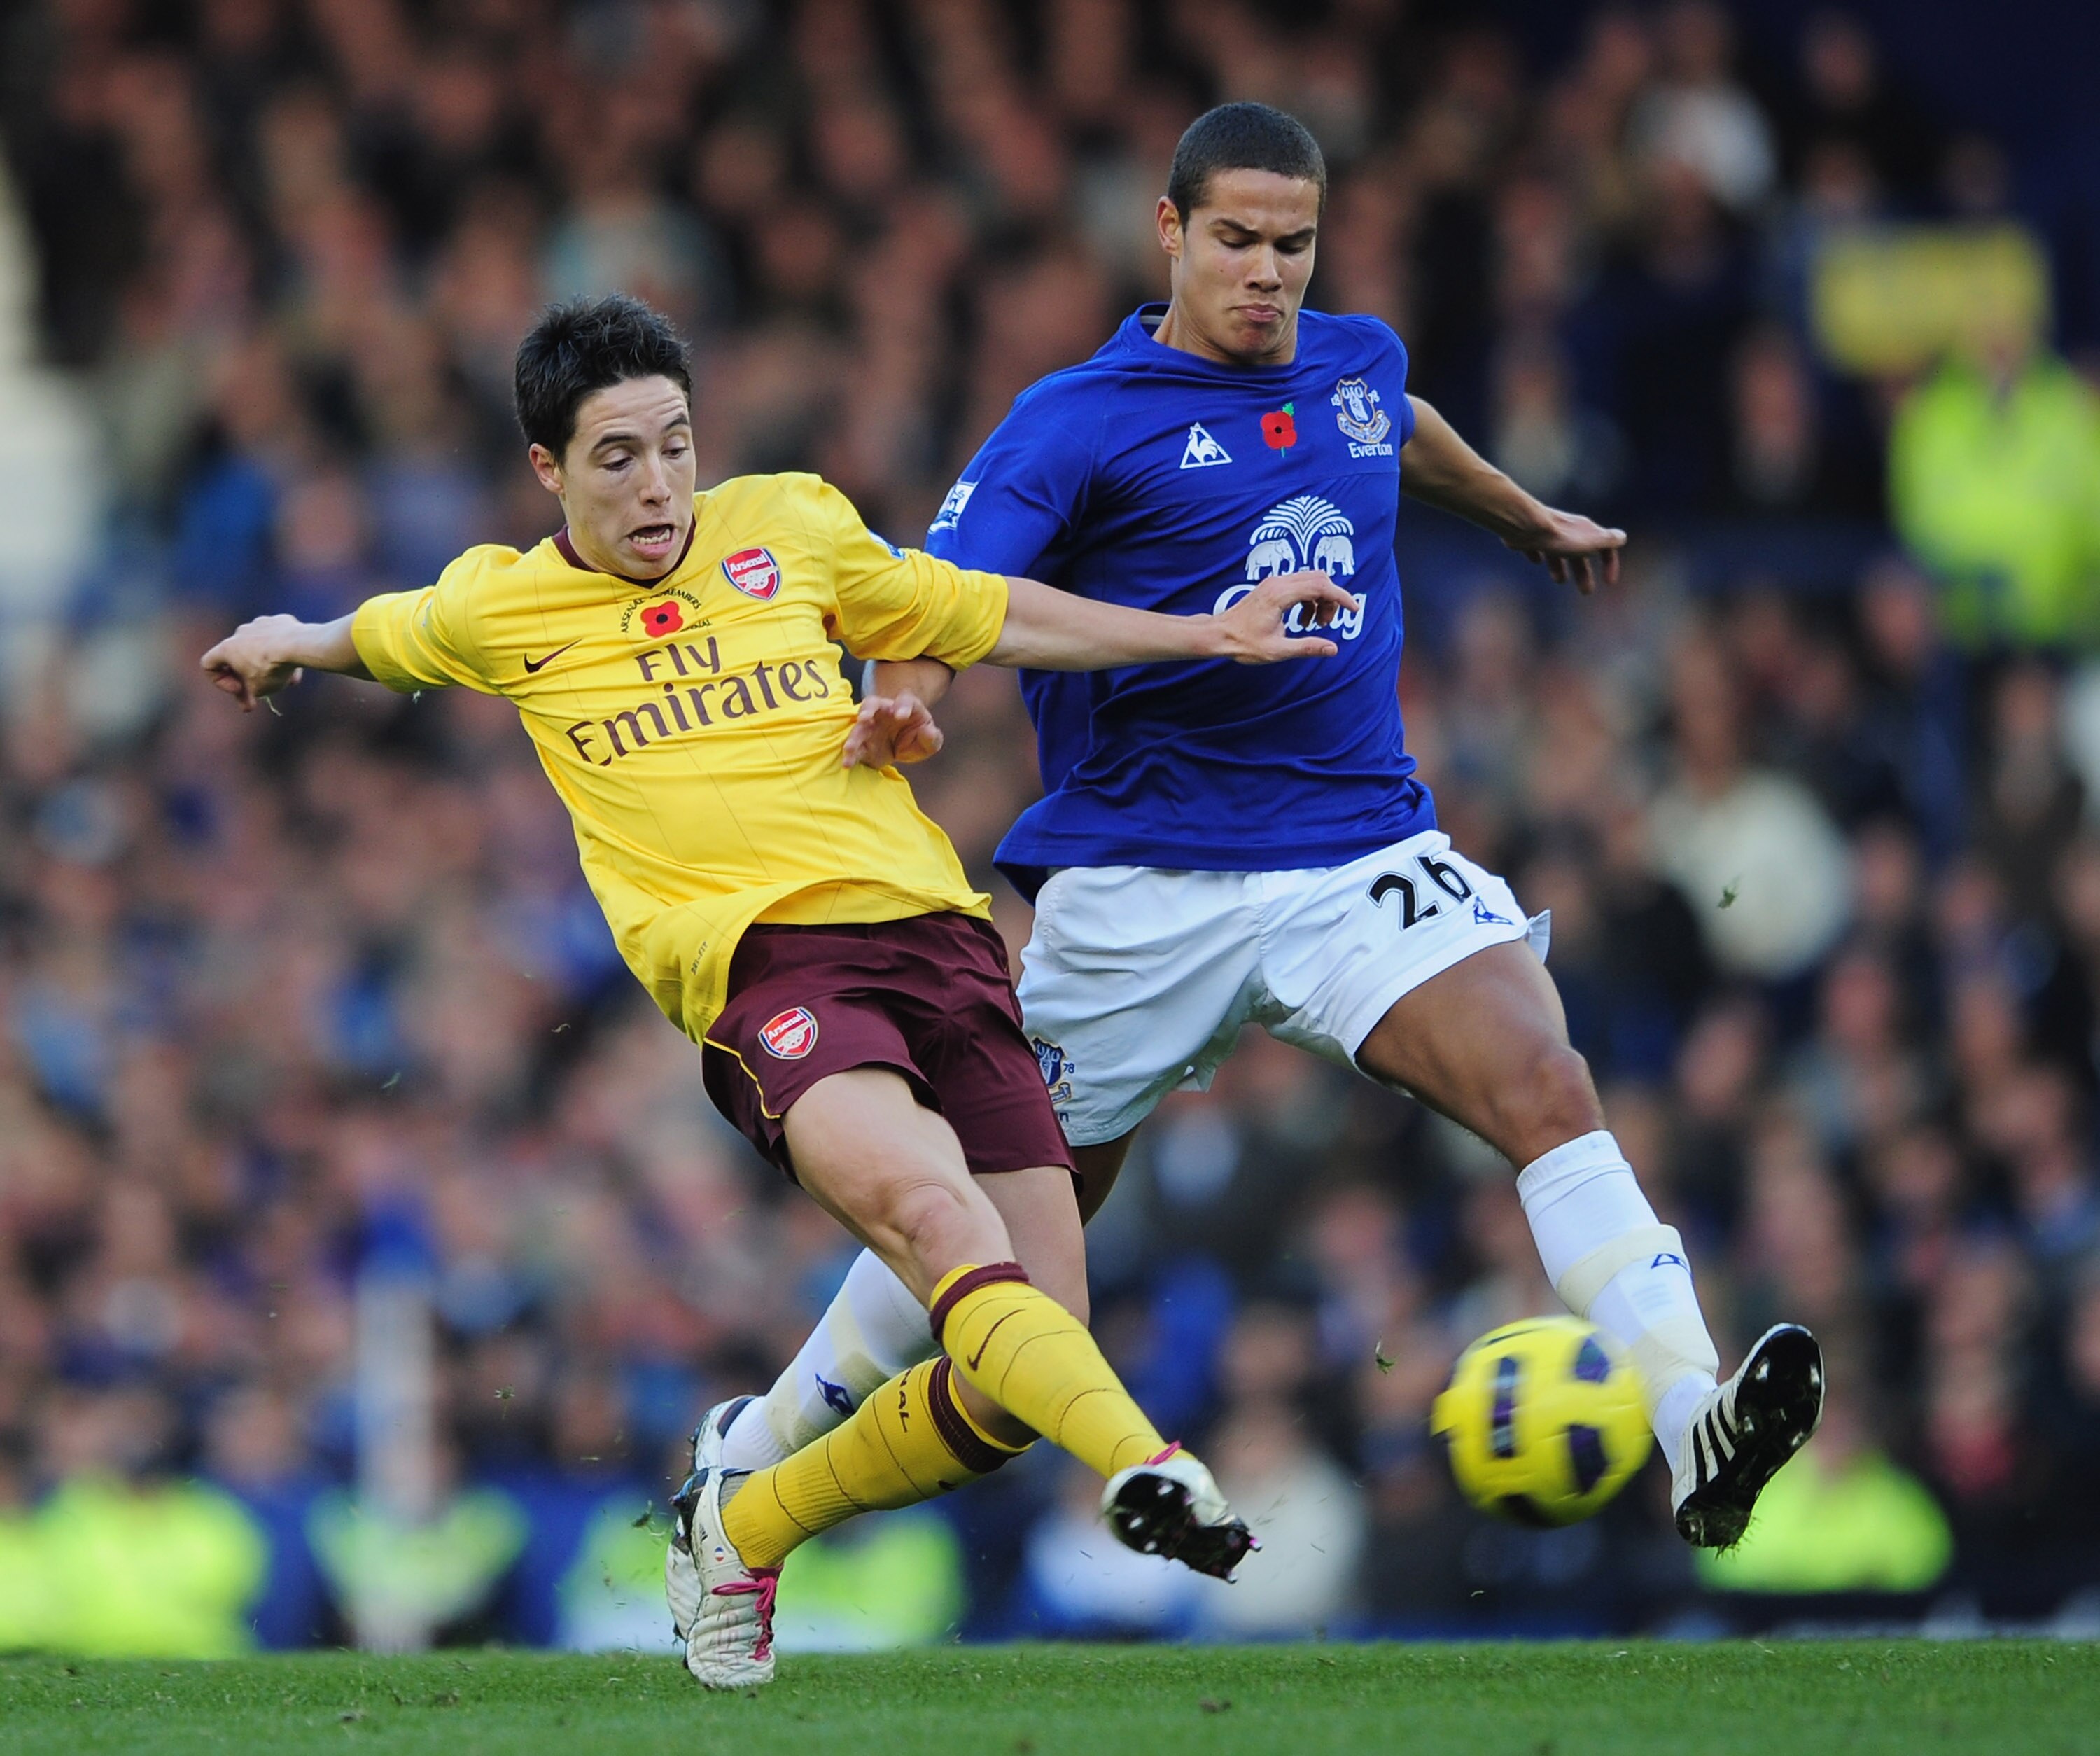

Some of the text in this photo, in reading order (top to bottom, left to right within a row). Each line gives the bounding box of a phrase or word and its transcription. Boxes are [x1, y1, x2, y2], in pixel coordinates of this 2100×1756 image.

[1348, 442, 1394, 459] Everton
[635, 636, 720, 682] Fly
[565, 659, 830, 767] Emirates
[1368, 856, 1473, 931] 26
